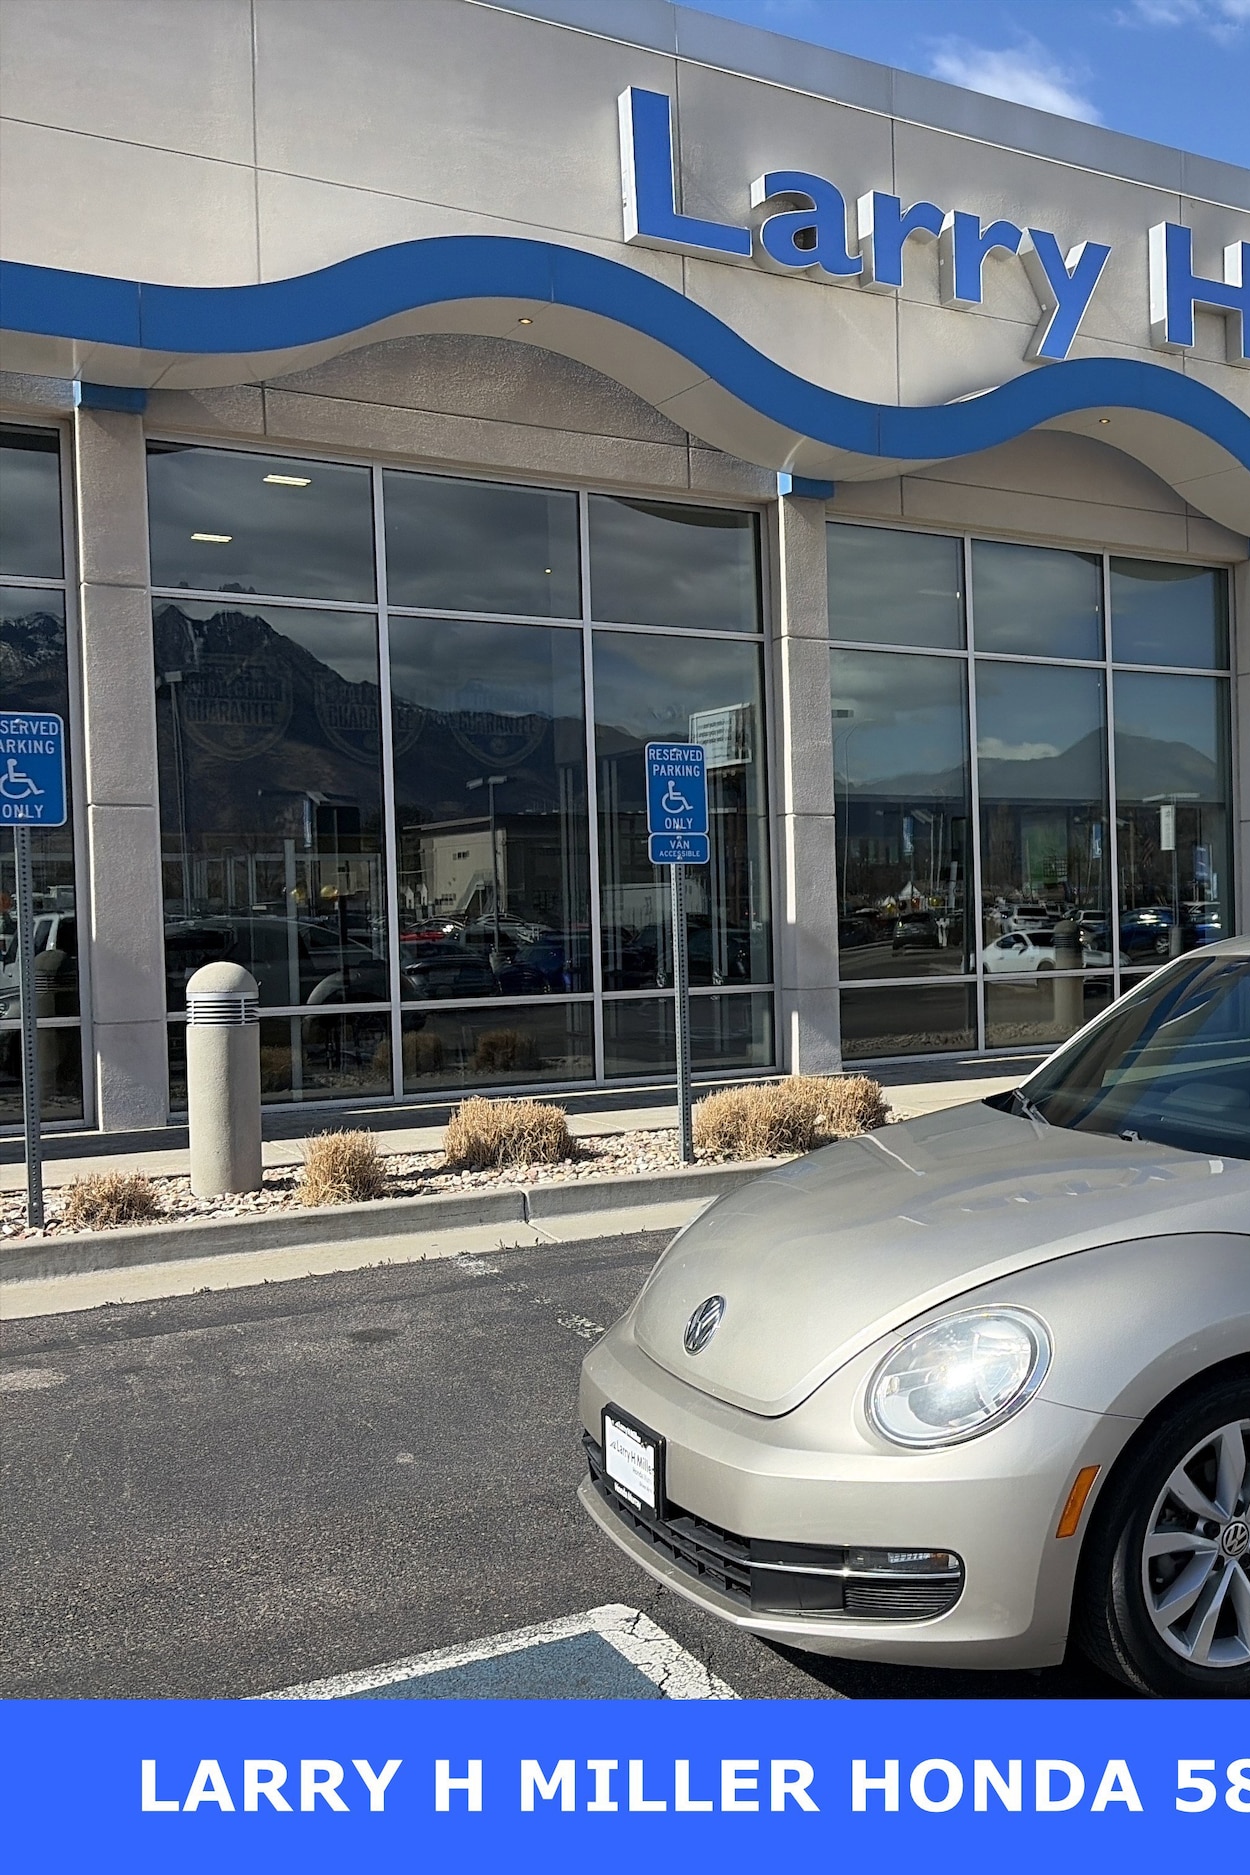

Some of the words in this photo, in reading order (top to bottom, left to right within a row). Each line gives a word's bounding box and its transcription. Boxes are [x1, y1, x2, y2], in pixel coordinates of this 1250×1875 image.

[619, 84, 1112, 361] Larry
[649, 748, 703, 762] RESERVED
[652, 764, 701, 777] PARKING
[2, 803, 44, 819] ONLY
[664, 817, 693, 830] ONLY
[669, 839, 690, 850] VAN
[658, 850, 701, 858] ACCESSIBLE
[616, 1439, 631, 1464] Larry
